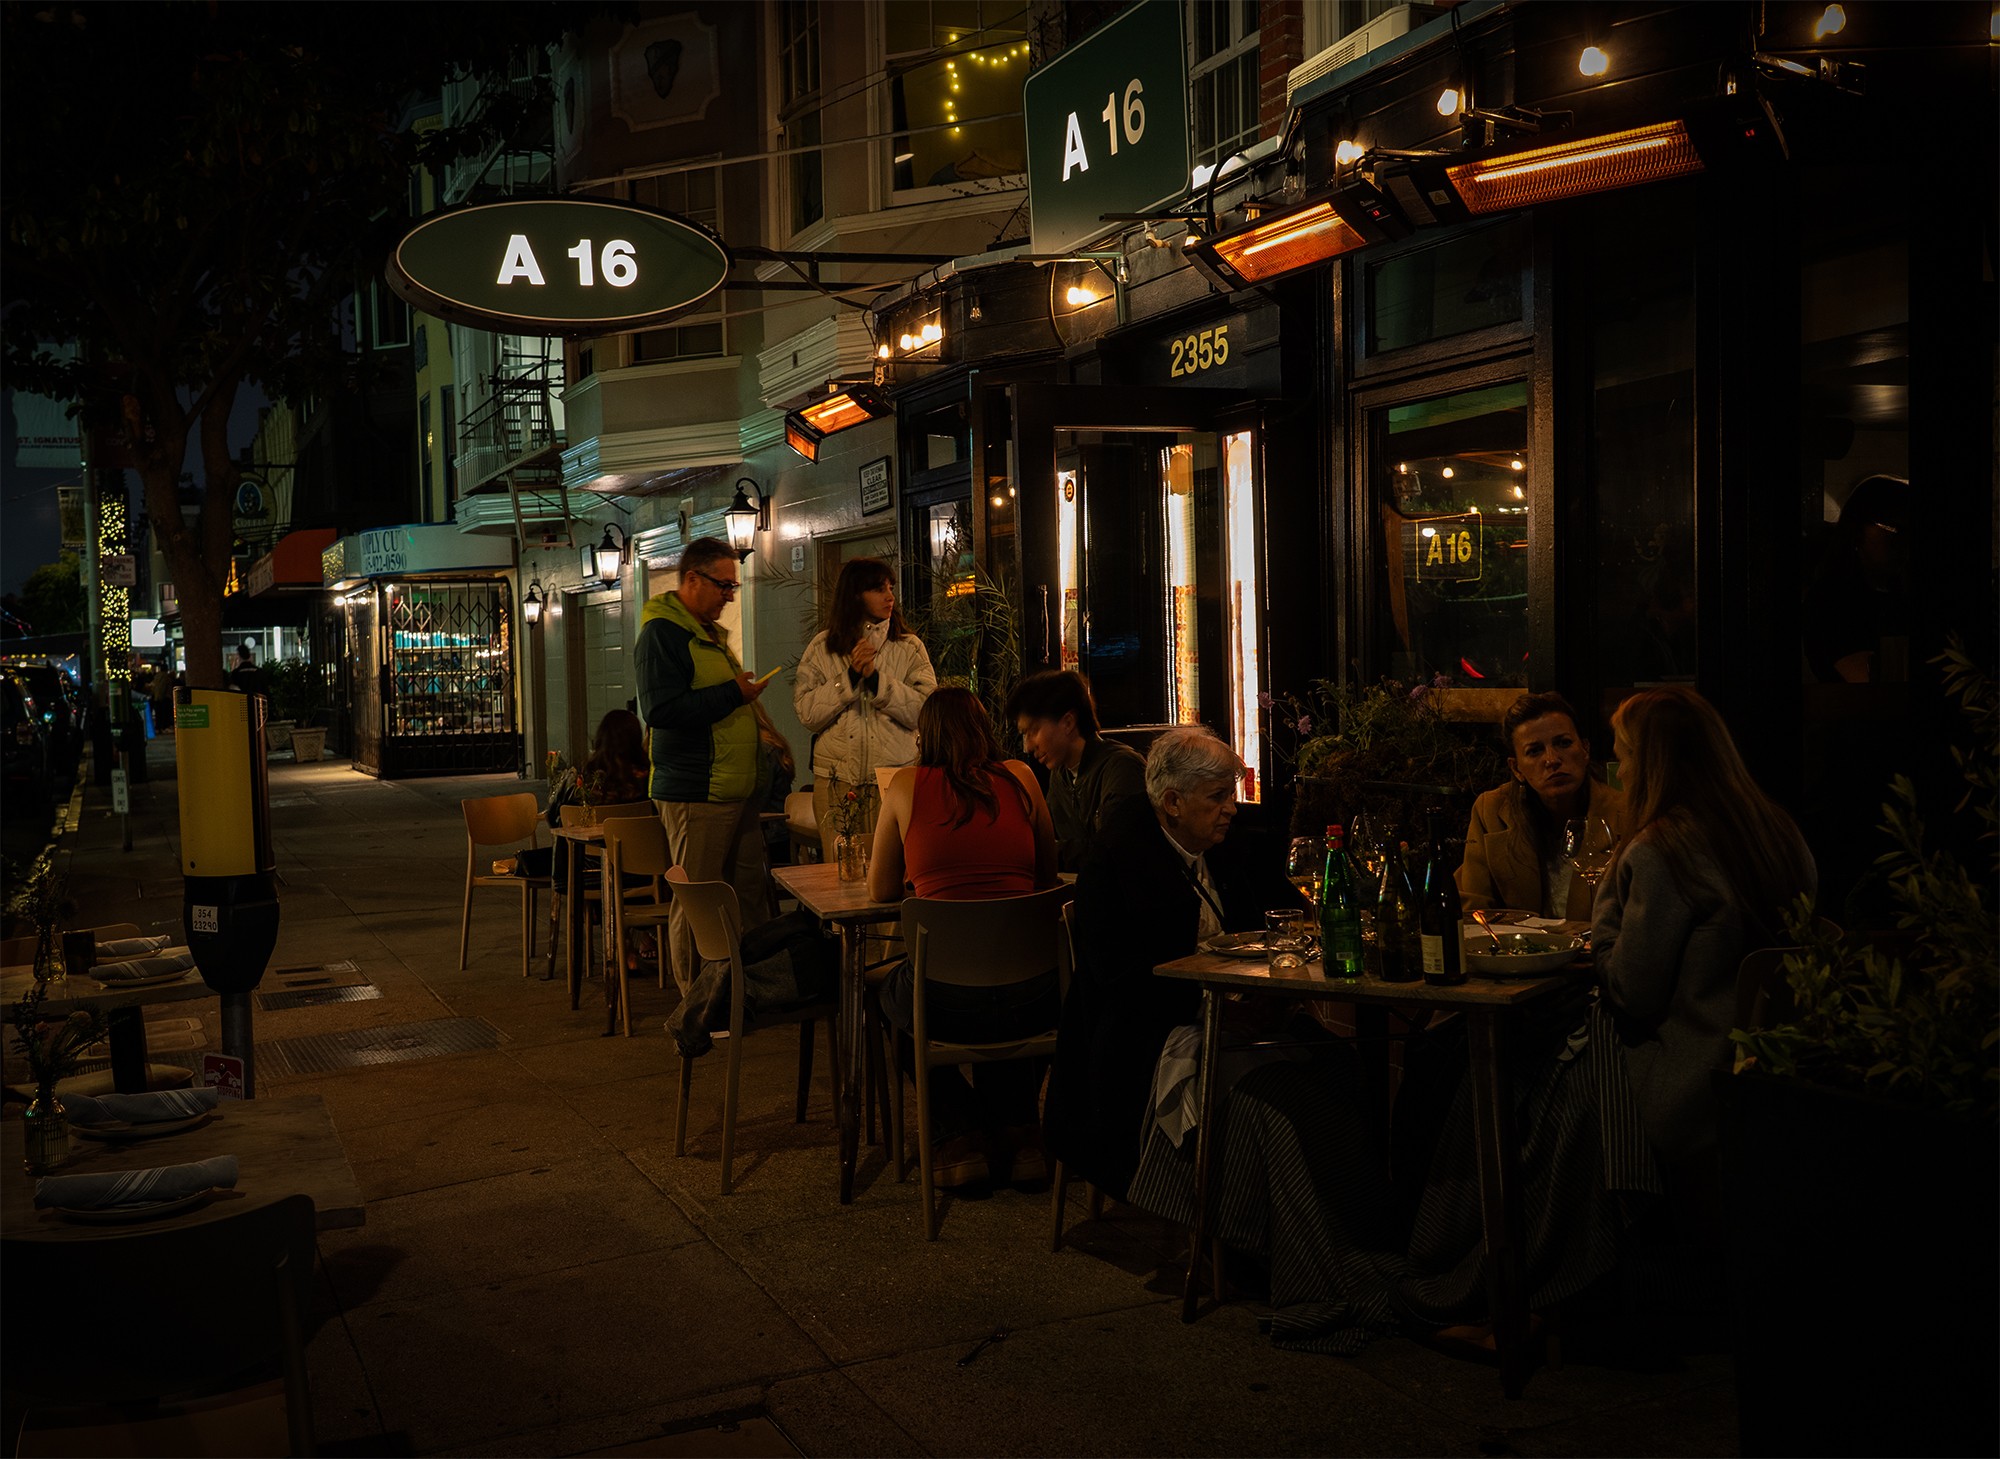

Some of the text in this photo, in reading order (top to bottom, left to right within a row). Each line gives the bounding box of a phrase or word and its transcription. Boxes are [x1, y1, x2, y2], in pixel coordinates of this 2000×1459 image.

[1062, 77, 1146, 182] A 16
[496, 234, 638, 288] A 16
[1170, 324, 1229, 378] 2355
[866, 473, 882, 485] CLEAR
[194, 920, 217, 931] 23290
[197, 908, 212, 918] 354
